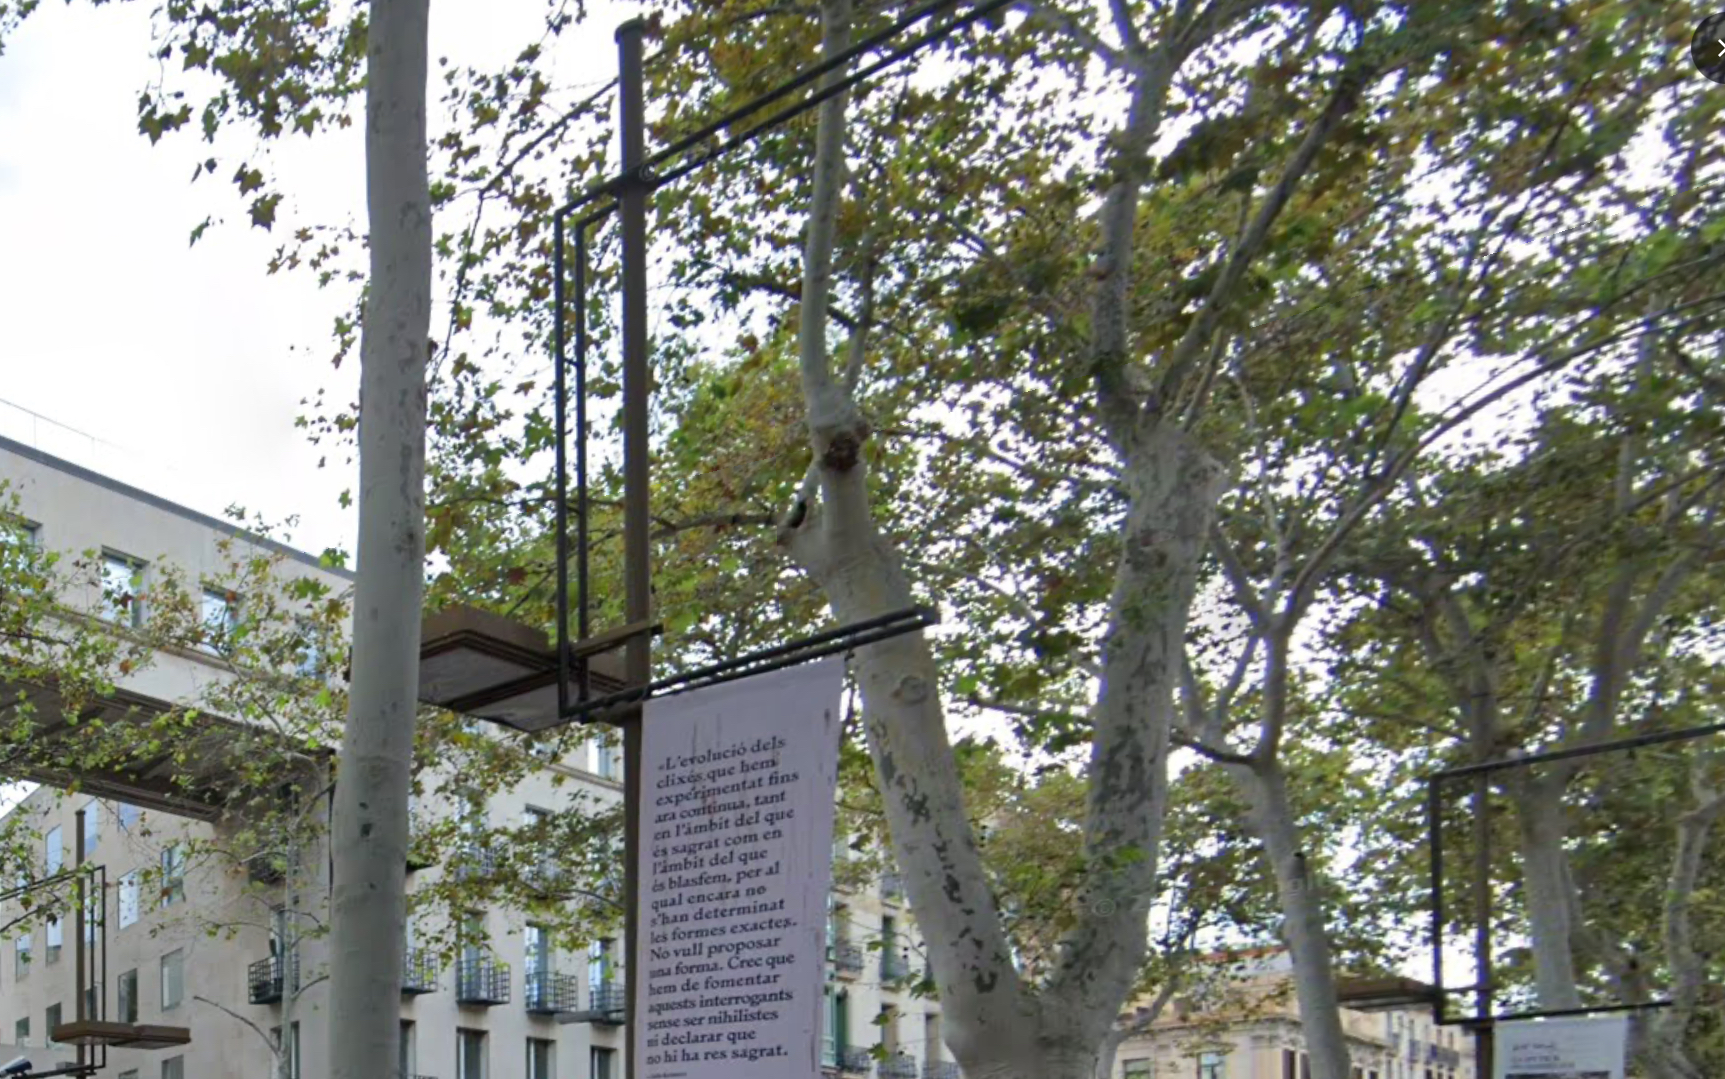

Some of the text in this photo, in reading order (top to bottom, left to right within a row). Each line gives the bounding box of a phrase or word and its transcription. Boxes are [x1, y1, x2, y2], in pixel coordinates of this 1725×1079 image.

[750, 735, 787, 751] dels
[707, 767, 735, 783] que
[656, 770, 800, 806] experimentat fins
[654, 811, 676, 824] ara
[754, 790, 786, 806] tant
[653, 828, 672, 841] en
[735, 810, 760, 827] del
[764, 808, 795, 826] que
[652, 828, 782, 857] és sagrat com en
[708, 850, 734, 867] del
[738, 849, 768, 867] que
[651, 878, 666, 893] és
[736, 868, 762, 883] per
[766, 864, 781, 876] al
[651, 885, 767, 912] qual encara no
[693, 898, 786, 921] determinat
[650, 931, 667, 944] les
[671, 924, 726, 941] formes
[649, 936, 782, 962] No vull proposar
[649, 952, 795, 979] una forma. Crec que
[648, 973, 782, 997] hem de fomentar
[648, 989, 793, 1016] aquests interrogants
[647, 1008, 779, 1031] sense ser nihilistes
[647, 1029, 756, 1047] ni declarar que
[646, 1054, 661, 1065] no
[664, 1050, 677, 1063] hi
[681, 1048, 699, 1062] ha
[703, 1048, 728, 1060] res
